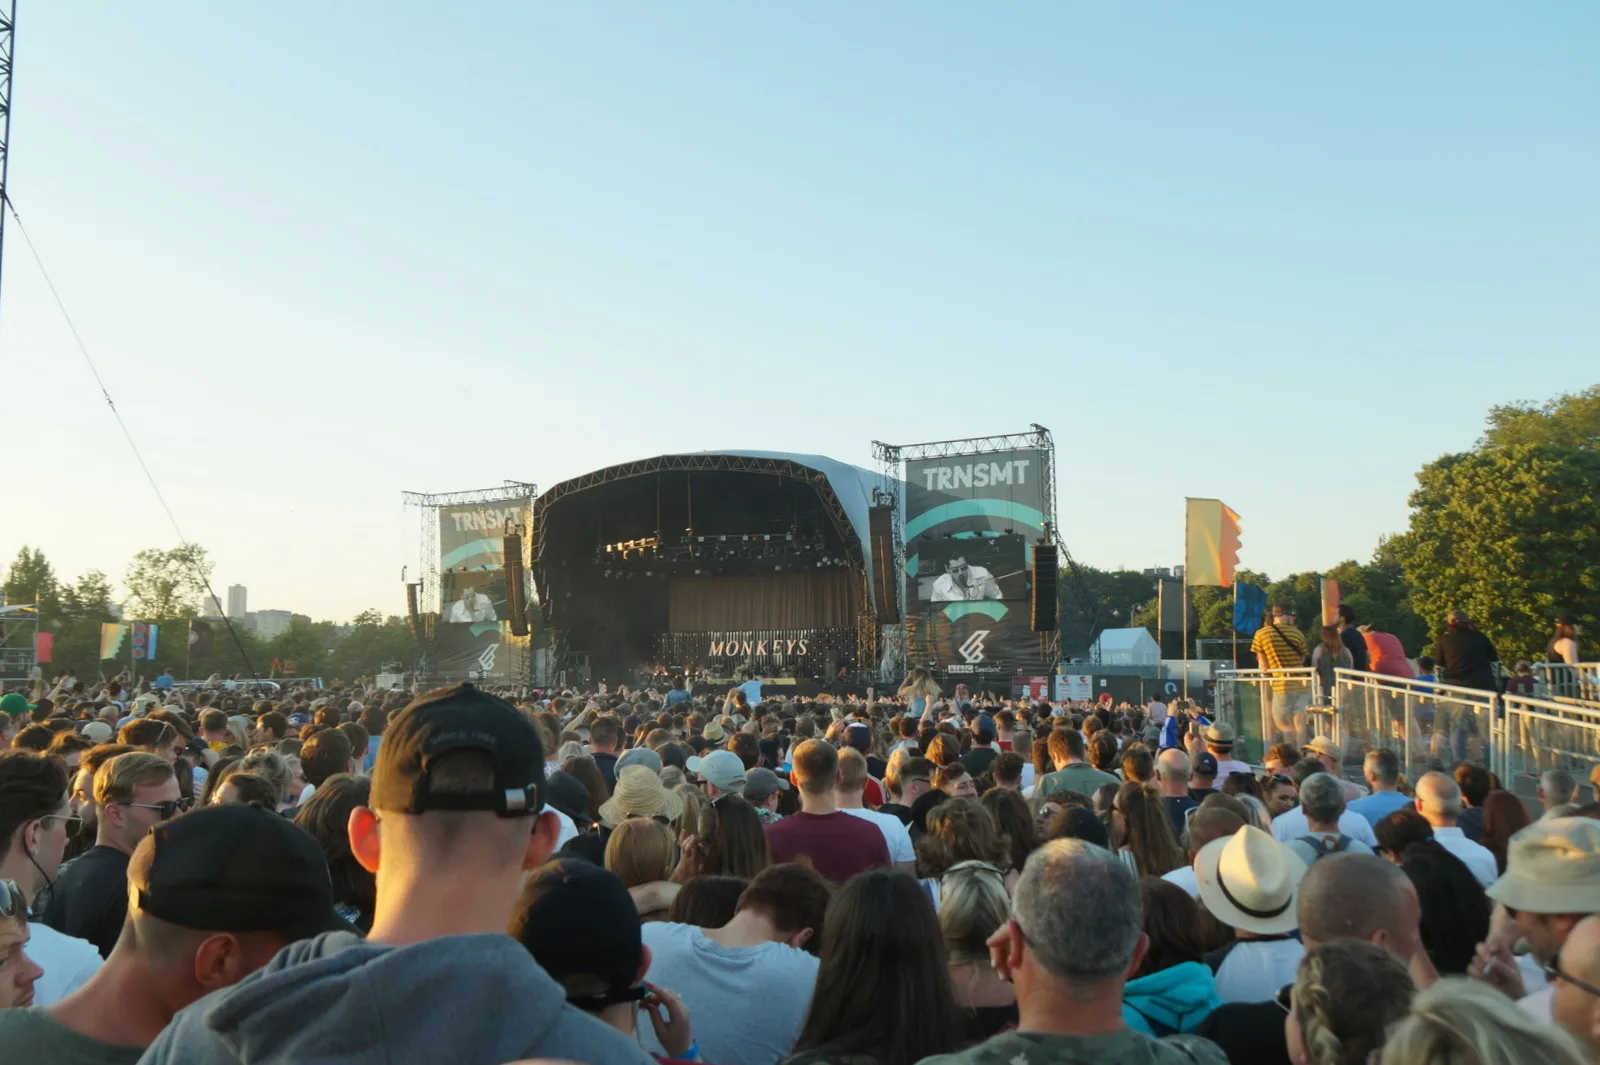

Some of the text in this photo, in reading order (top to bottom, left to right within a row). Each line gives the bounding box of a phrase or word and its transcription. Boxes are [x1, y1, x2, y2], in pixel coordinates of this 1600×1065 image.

[922, 460, 1030, 491] TRNSMT
[451, 507, 521, 532] TRNSMT
[708, 639, 811, 656] MONKEYS
